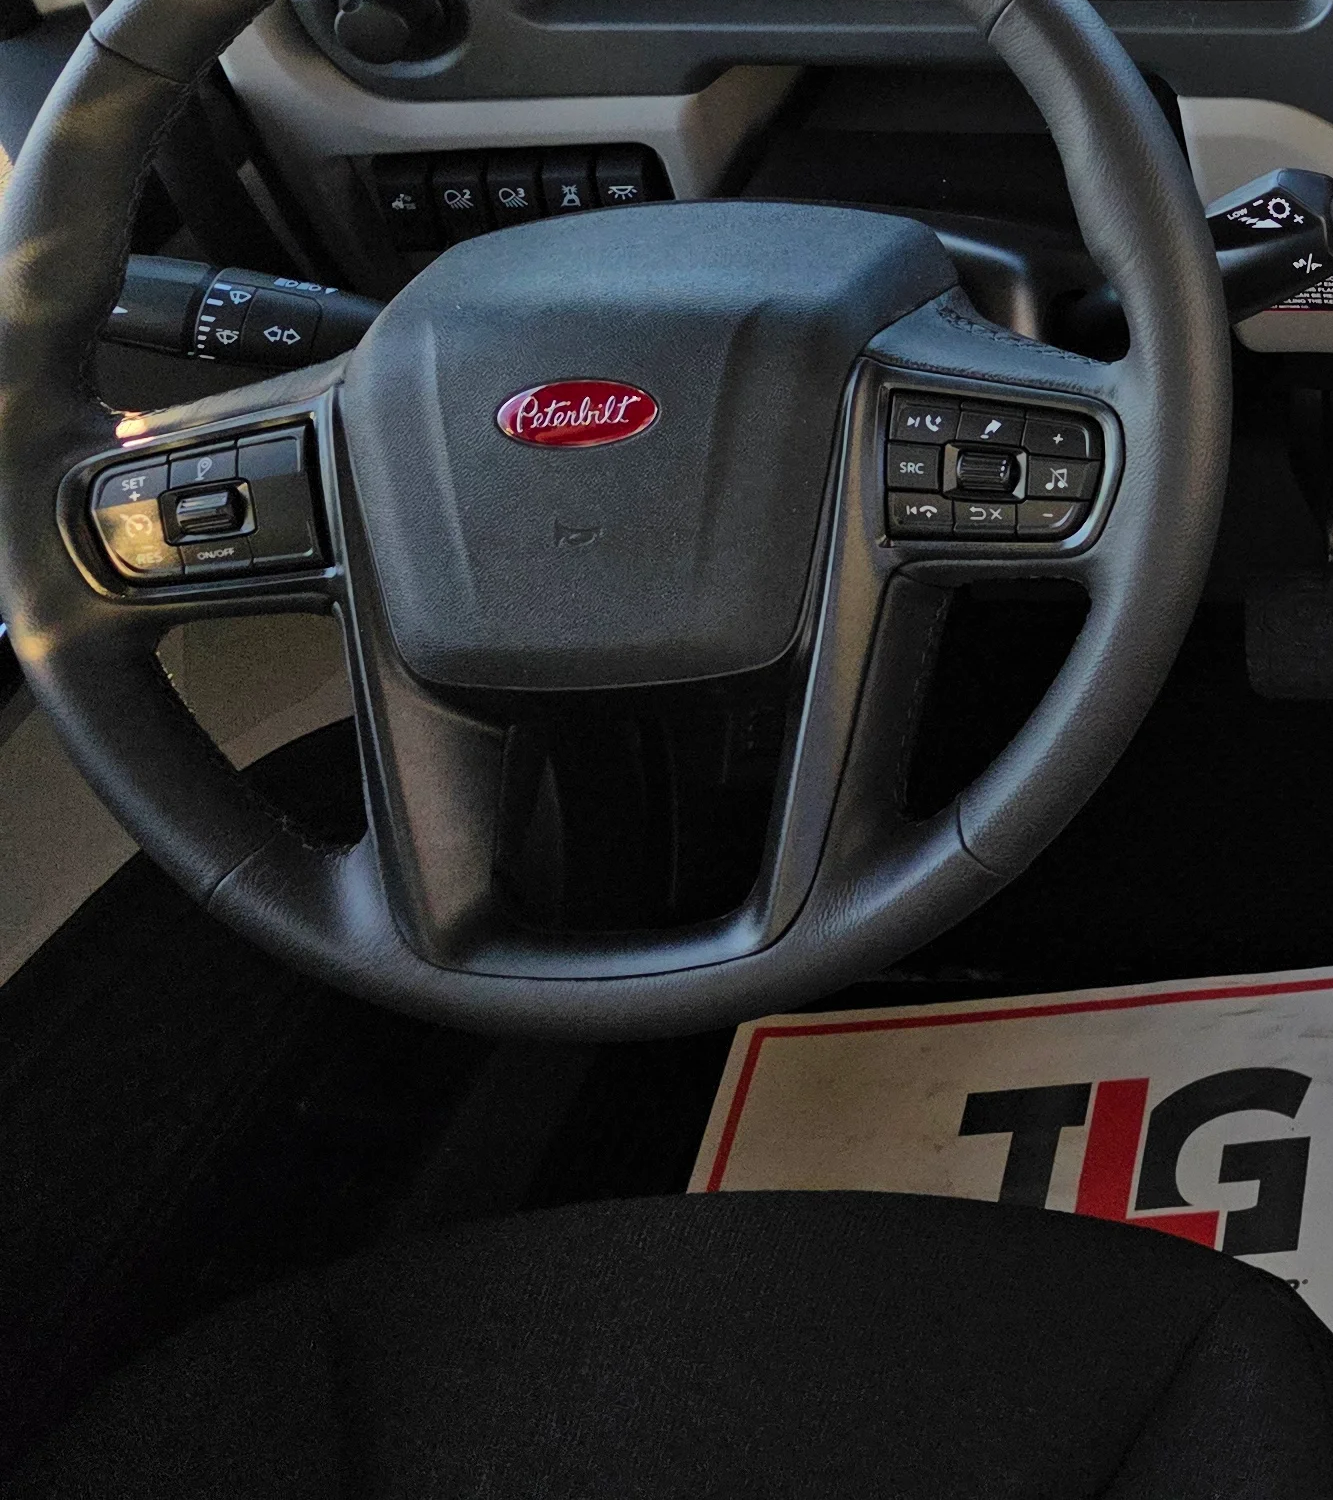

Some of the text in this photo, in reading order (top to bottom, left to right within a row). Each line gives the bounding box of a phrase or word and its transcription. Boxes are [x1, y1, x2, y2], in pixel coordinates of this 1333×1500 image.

[1226, 207, 1248, 220] LOW
[516, 395, 642, 433] Peterbilt
[900, 461, 925, 475] SRC
[121, 476, 147, 491] SET
[196, 547, 236, 560] ON/OFF
[958, 1066, 1312, 1257] TLG
